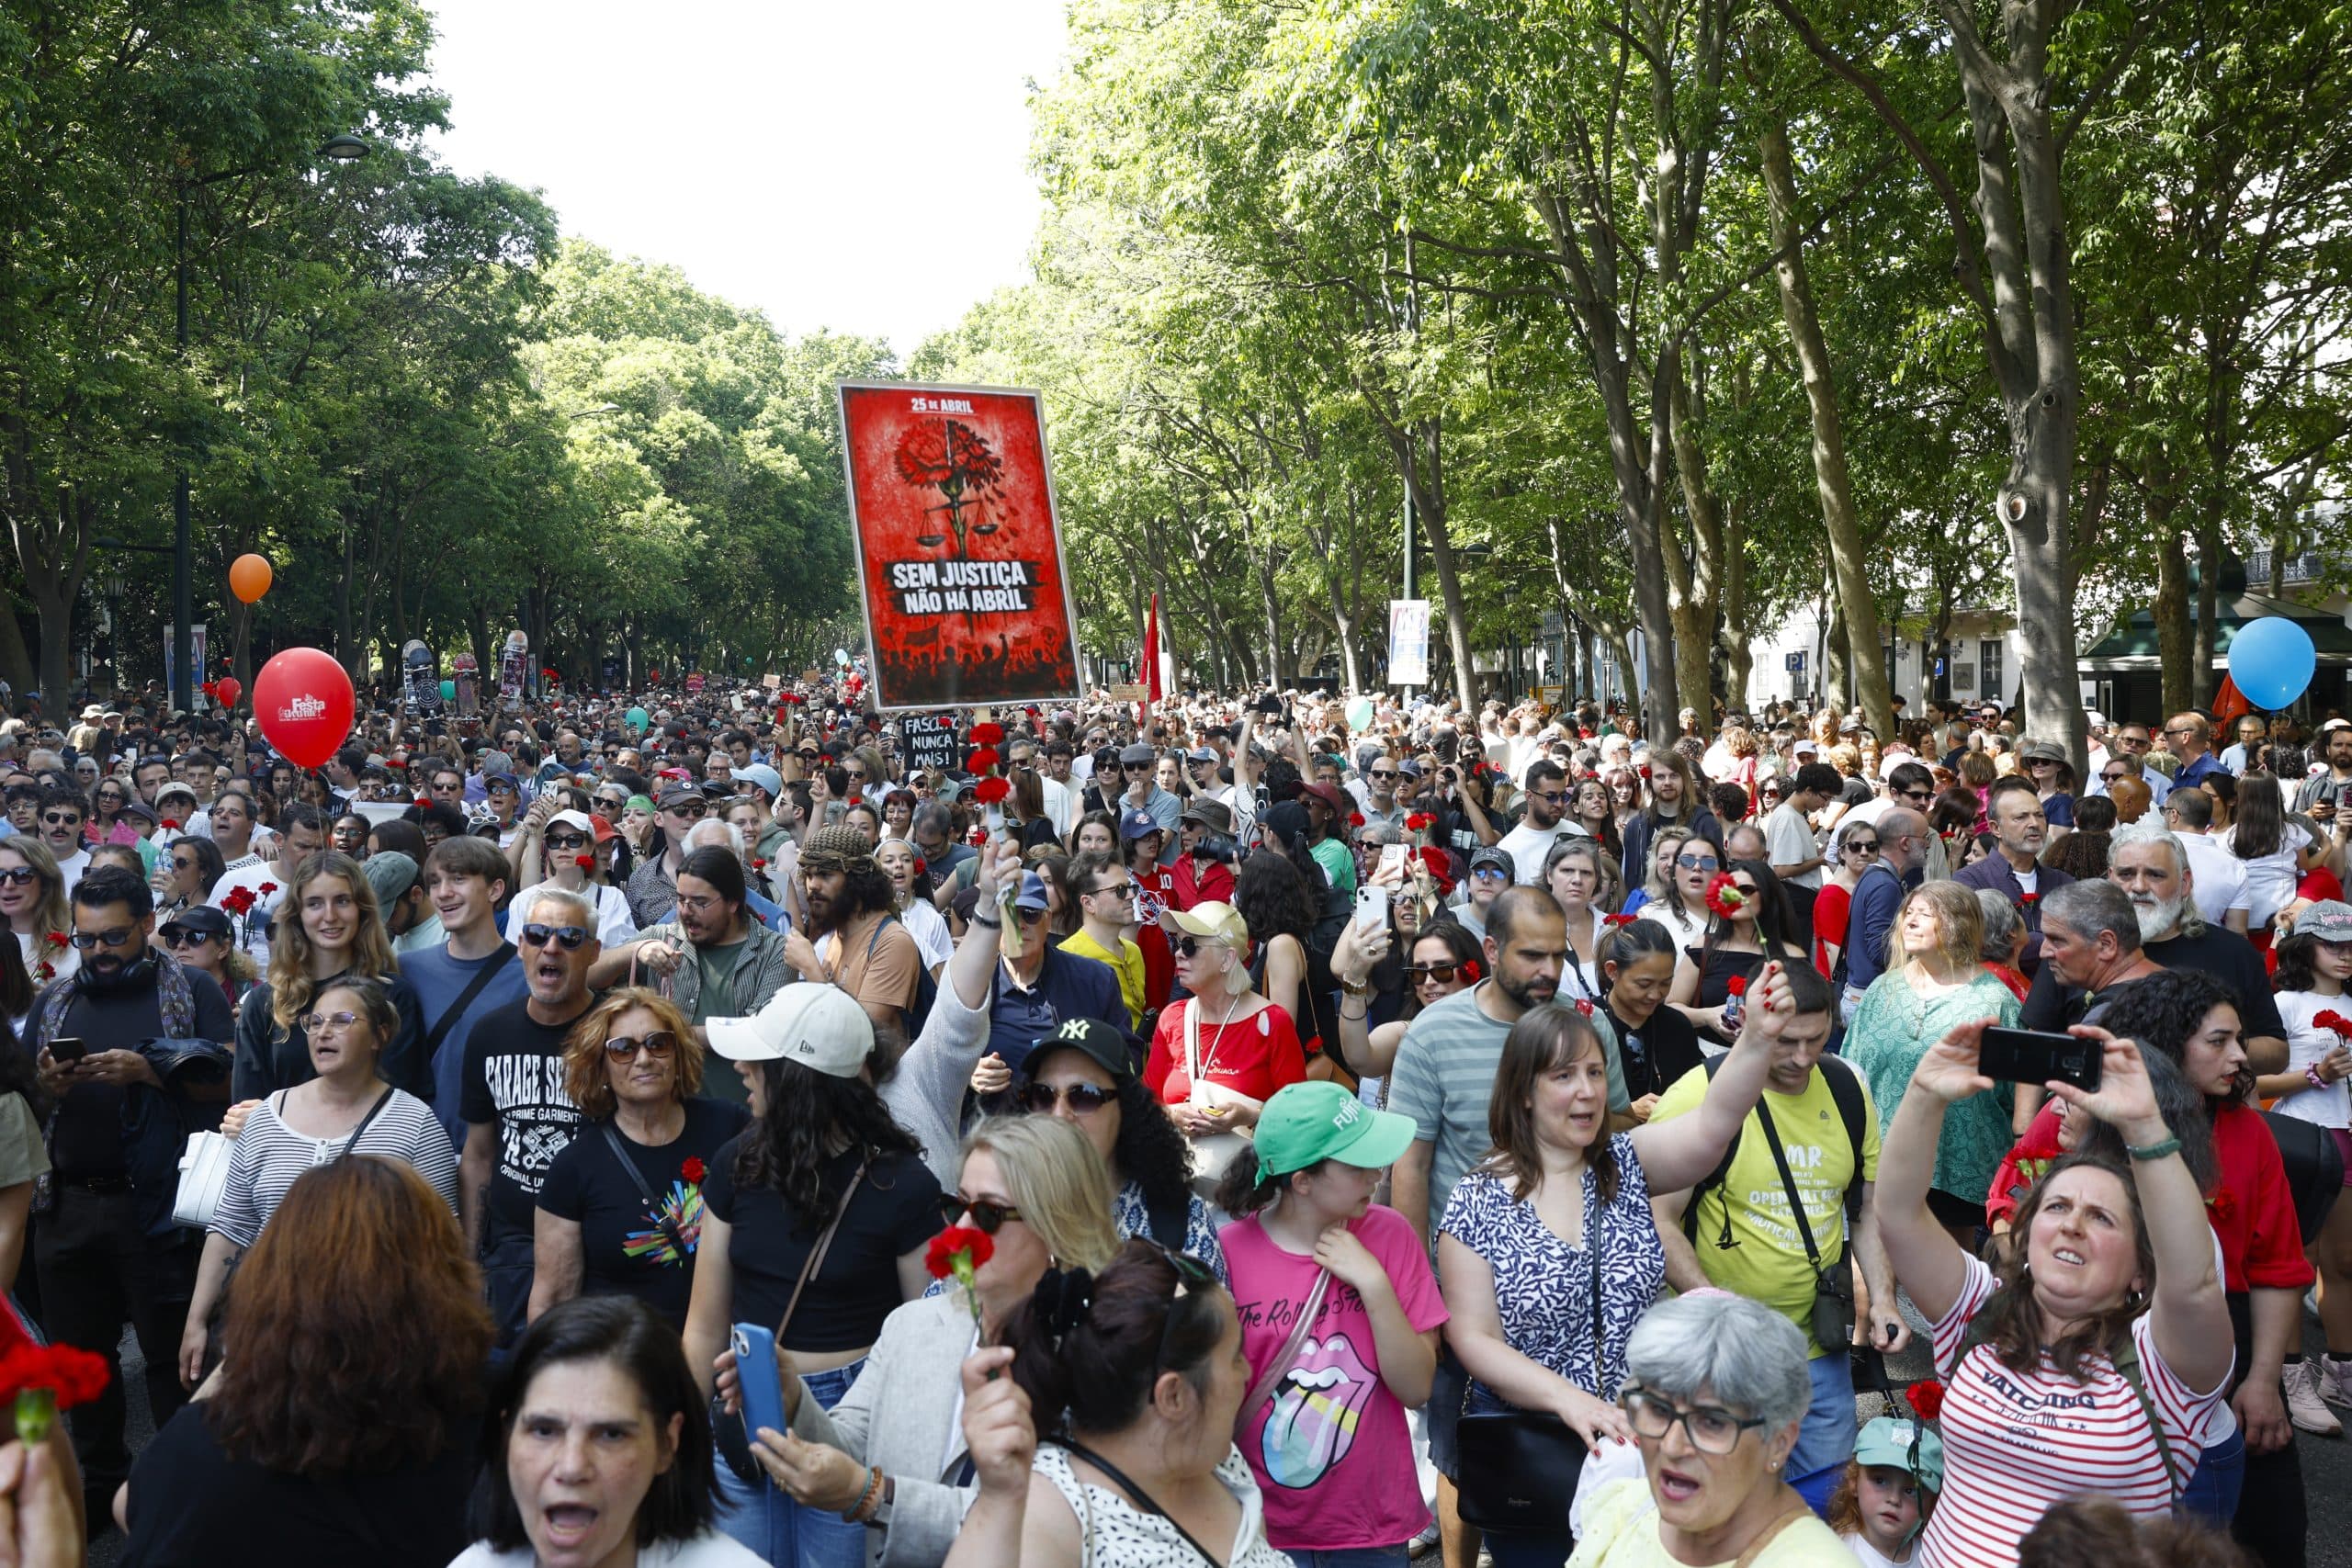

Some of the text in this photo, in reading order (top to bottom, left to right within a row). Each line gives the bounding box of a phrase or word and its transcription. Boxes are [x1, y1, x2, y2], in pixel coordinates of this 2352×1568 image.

[911, 398, 927, 412] 25
[941, 399, 974, 413] ABRIL
[892, 561, 1028, 589] SEM JUSTIÇA
[904, 587, 1027, 614] NÃO HÁ ABRIL
[1789, 654, 1800, 670] P
[912, 734, 954, 750] NUNCA
[1159, 873, 1172, 890] 10
[1058, 1019, 1091, 1040] NY
[485, 1054, 541, 1111] GARAGE
[512, 1107, 582, 1123] PRIME GARMENT
[1785, 1144, 1823, 1168] MR
[500, 1164, 532, 1186] ORIGINAL
[1748, 1190, 1791, 1206] OPEN
[1236, 1301, 1262, 1328] The
[1266, 1298, 1329, 1337] Rollg
